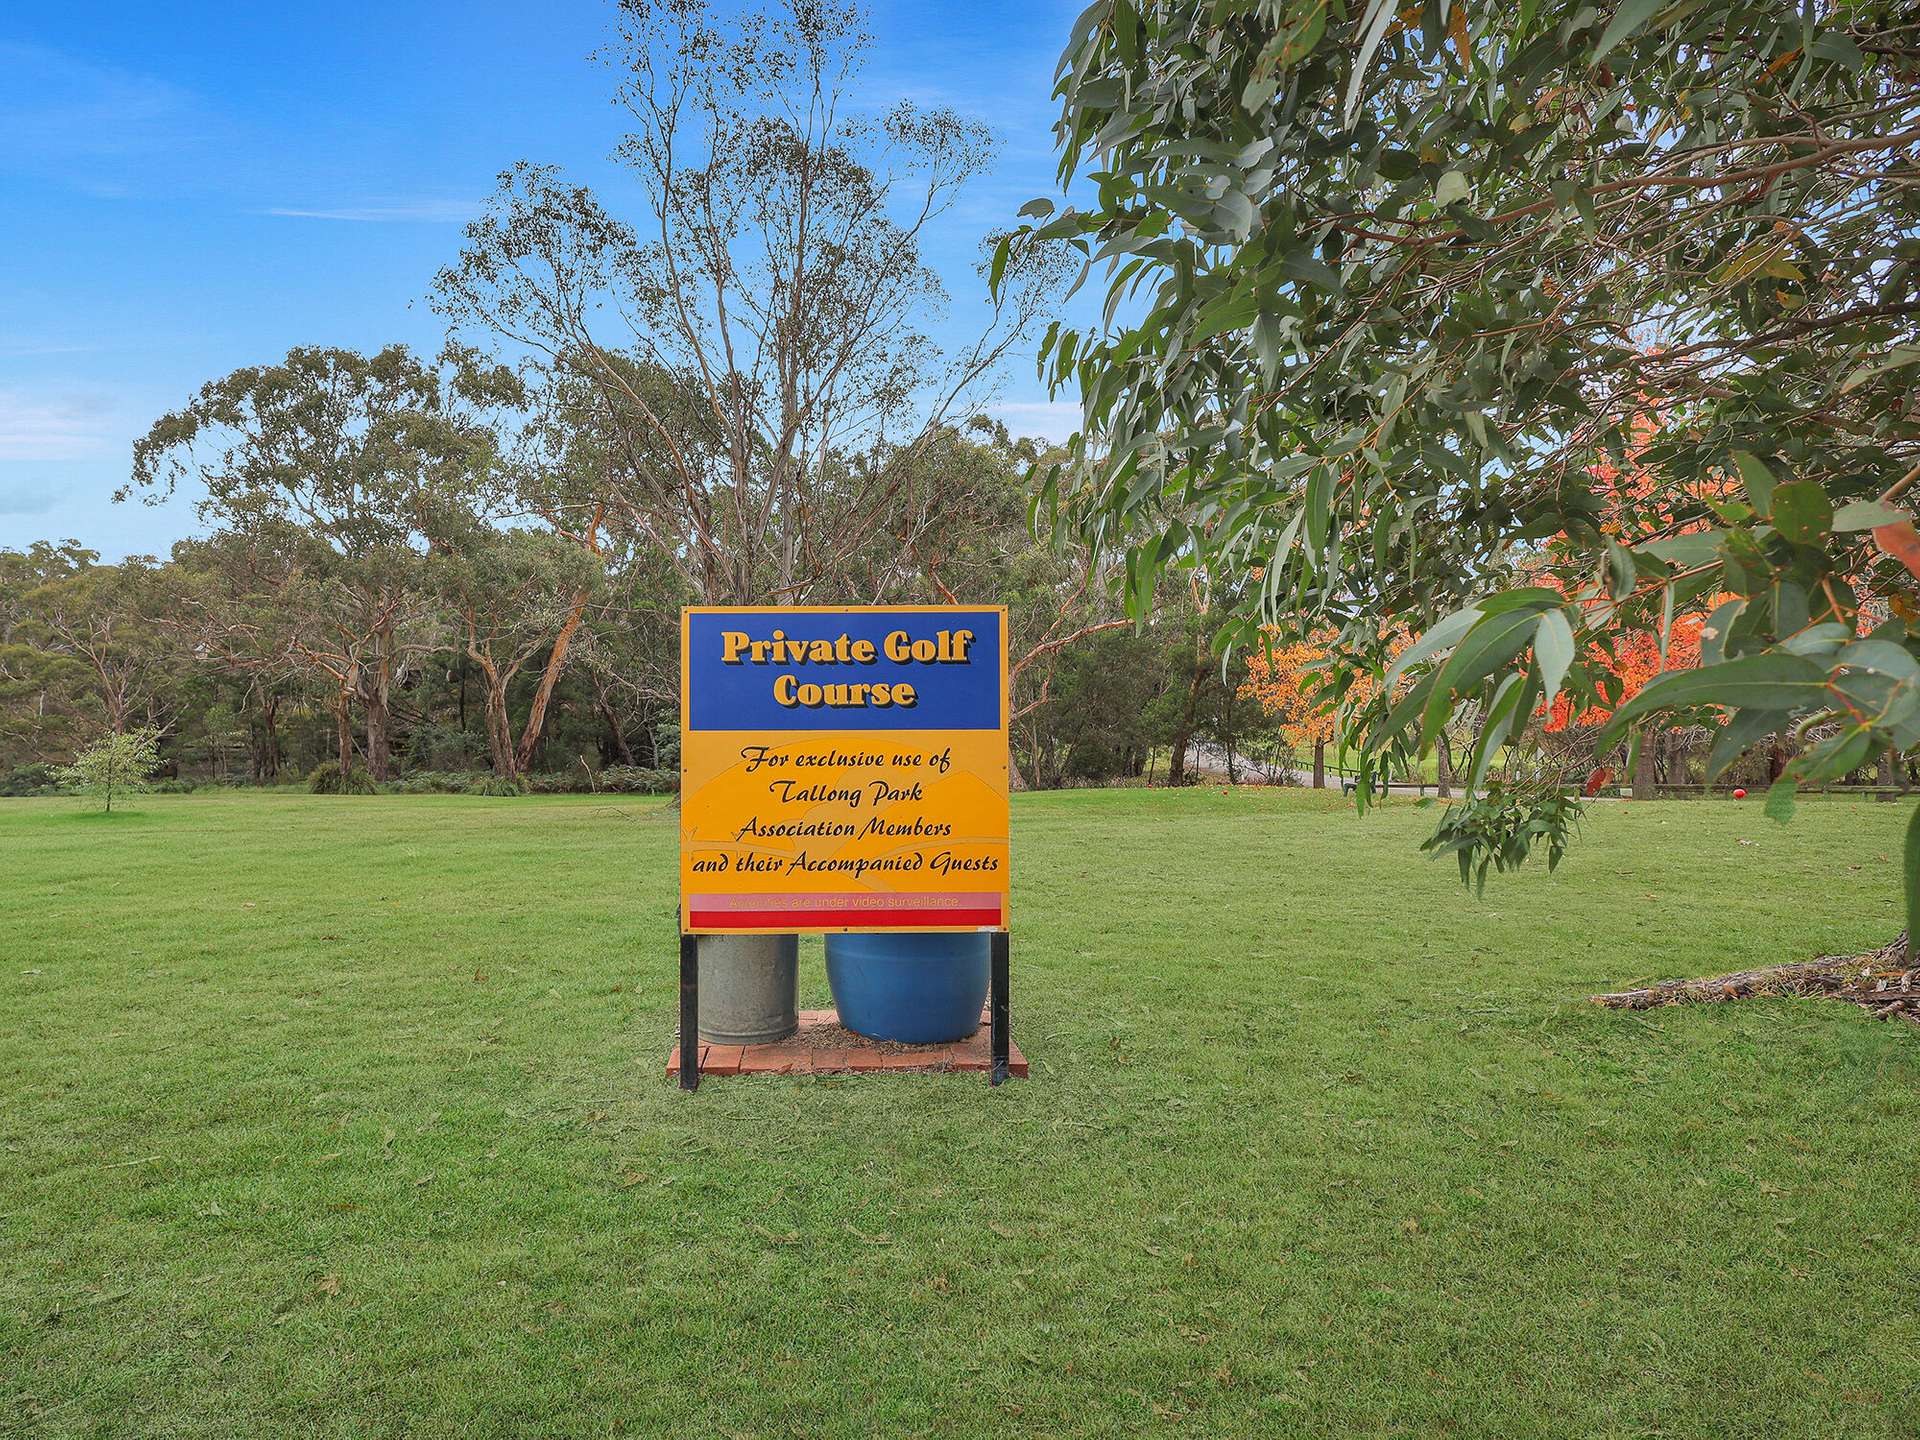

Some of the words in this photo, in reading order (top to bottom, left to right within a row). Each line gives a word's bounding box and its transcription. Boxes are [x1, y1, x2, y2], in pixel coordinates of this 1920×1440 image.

[720, 629, 877, 665] Private
[883, 629, 977, 665] Golf
[773, 674, 919, 708] Course
[740, 746, 789, 772] For
[795, 750, 884, 767] exclusive
[892, 752, 922, 767] use
[928, 747, 951, 773] of
[769, 780, 861, 808] Tallong
[868, 780, 923, 806] Park
[737, 816, 855, 842] Association
[857, 817, 952, 840] Members
[692, 853, 729, 873] and
[735, 854, 783, 873] their
[786, 850, 923, 878] Accompanied
[929, 852, 998, 875] Guests
[791, 897, 812, 909] are
[815, 896, 848, 909] under
[852, 895, 885, 908] video
[888, 895, 960, 908] surveillance
